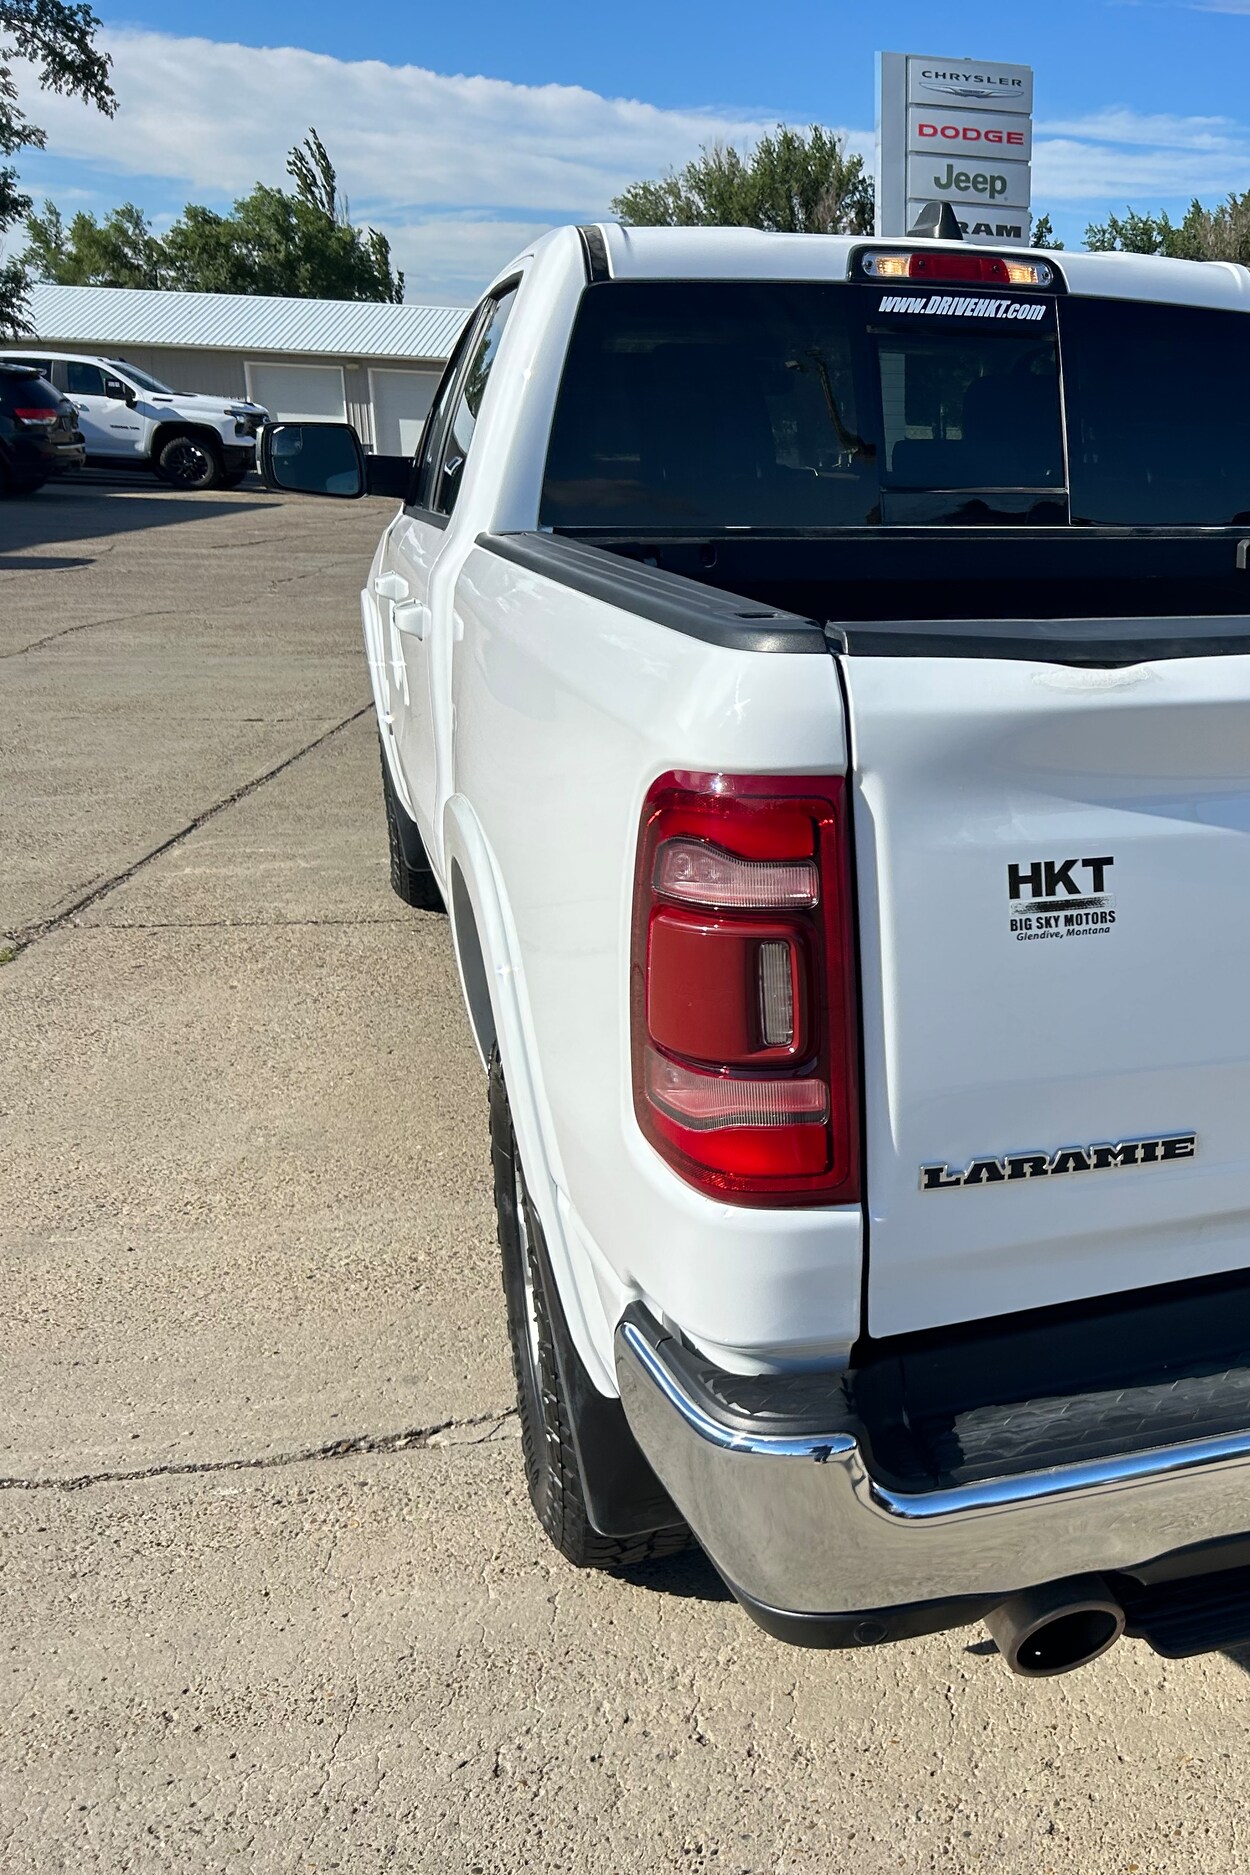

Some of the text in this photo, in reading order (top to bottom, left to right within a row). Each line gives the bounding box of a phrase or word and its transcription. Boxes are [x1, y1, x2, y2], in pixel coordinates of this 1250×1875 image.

[921, 70, 1022, 87] CHRYSLER
[918, 123, 1025, 145] DODGE
[933, 163, 1007, 199] Jeep
[878, 295, 1047, 321] www.DRIVEHKT.com
[1007, 856, 1114, 900] HKT
[1010, 910, 1116, 932] BIG SKY MOTORS
[1016, 926, 1111, 942] Glendive, Montana
[919, 1130, 1198, 1192] LARAMIE
